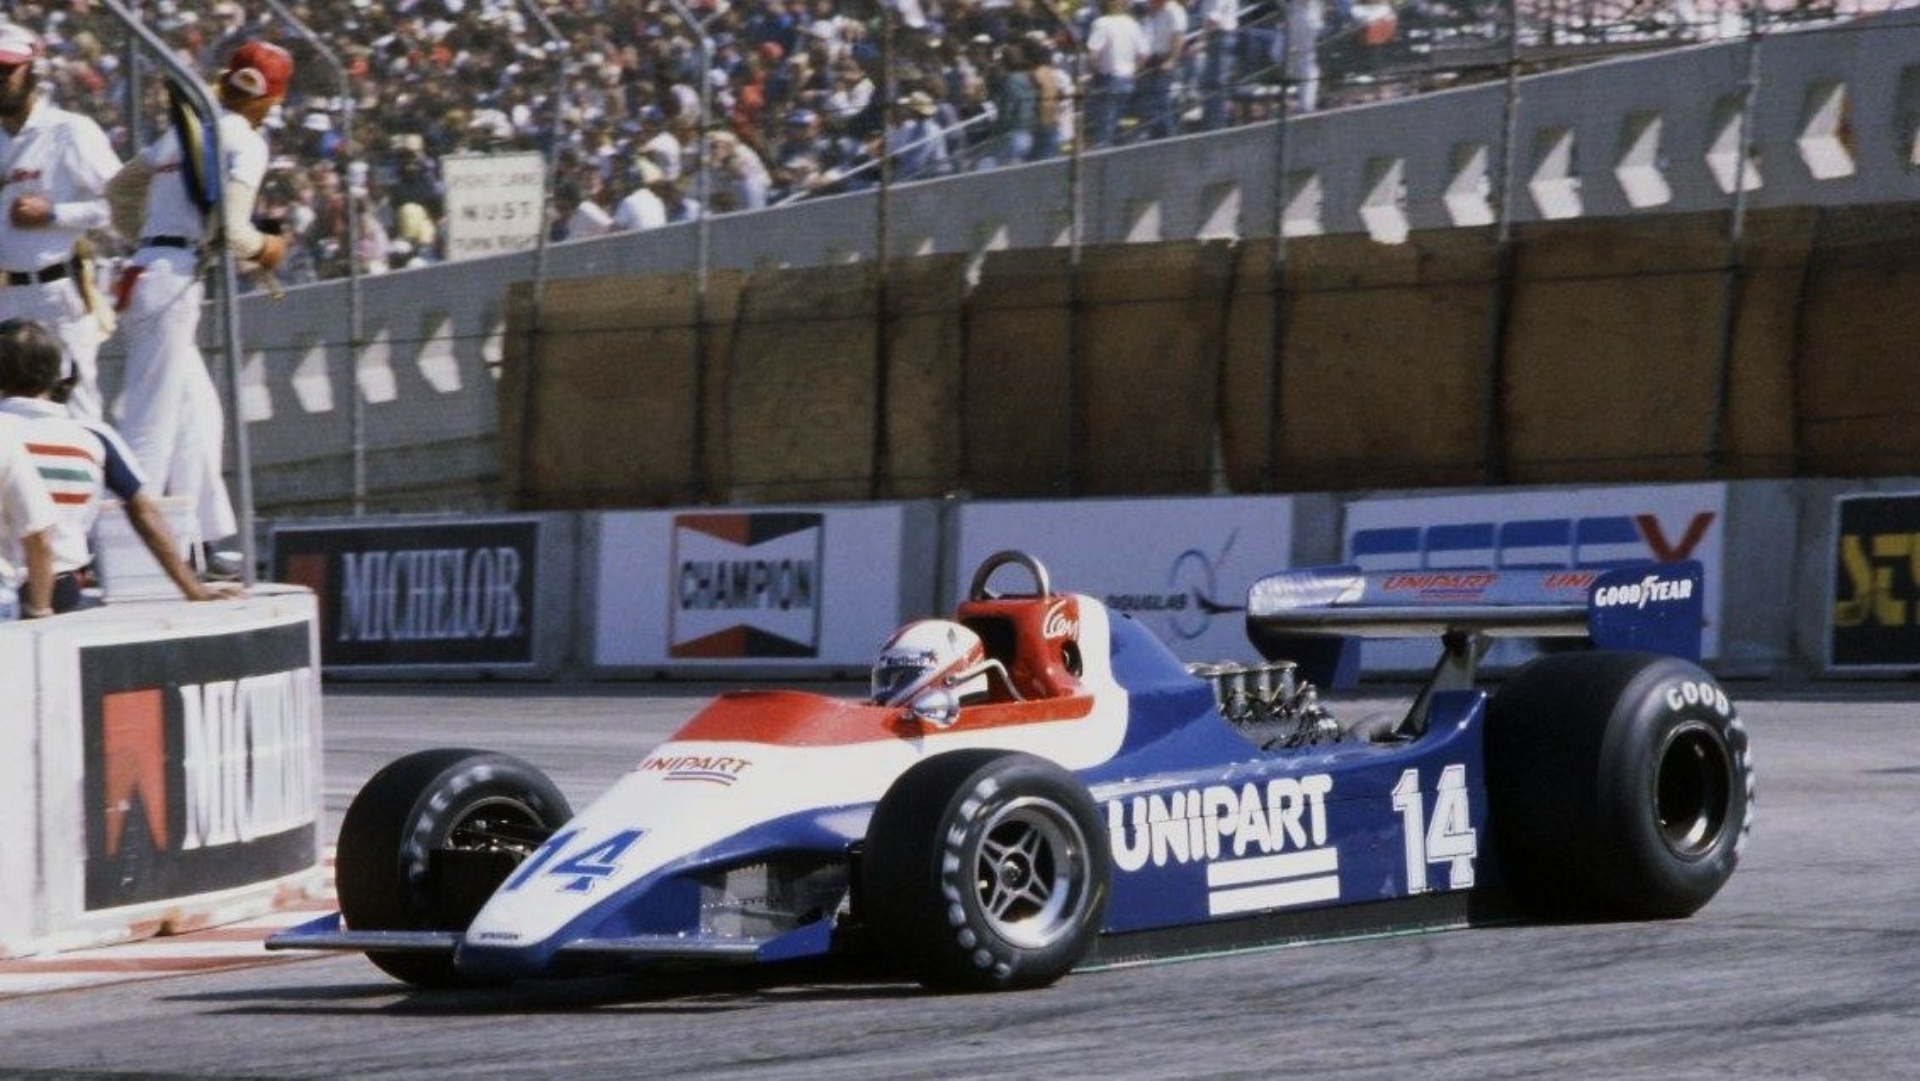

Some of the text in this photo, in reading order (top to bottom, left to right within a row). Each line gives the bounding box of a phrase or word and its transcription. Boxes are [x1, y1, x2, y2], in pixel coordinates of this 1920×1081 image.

[462, 201, 531, 220] MUST
[337, 547, 521, 642] MICHELOB
[680, 559, 817, 612] CHAMPION
[503, 827, 652, 894] 14
[1108, 773, 1333, 873] UNIPART
[1391, 763, 1478, 895] 14
